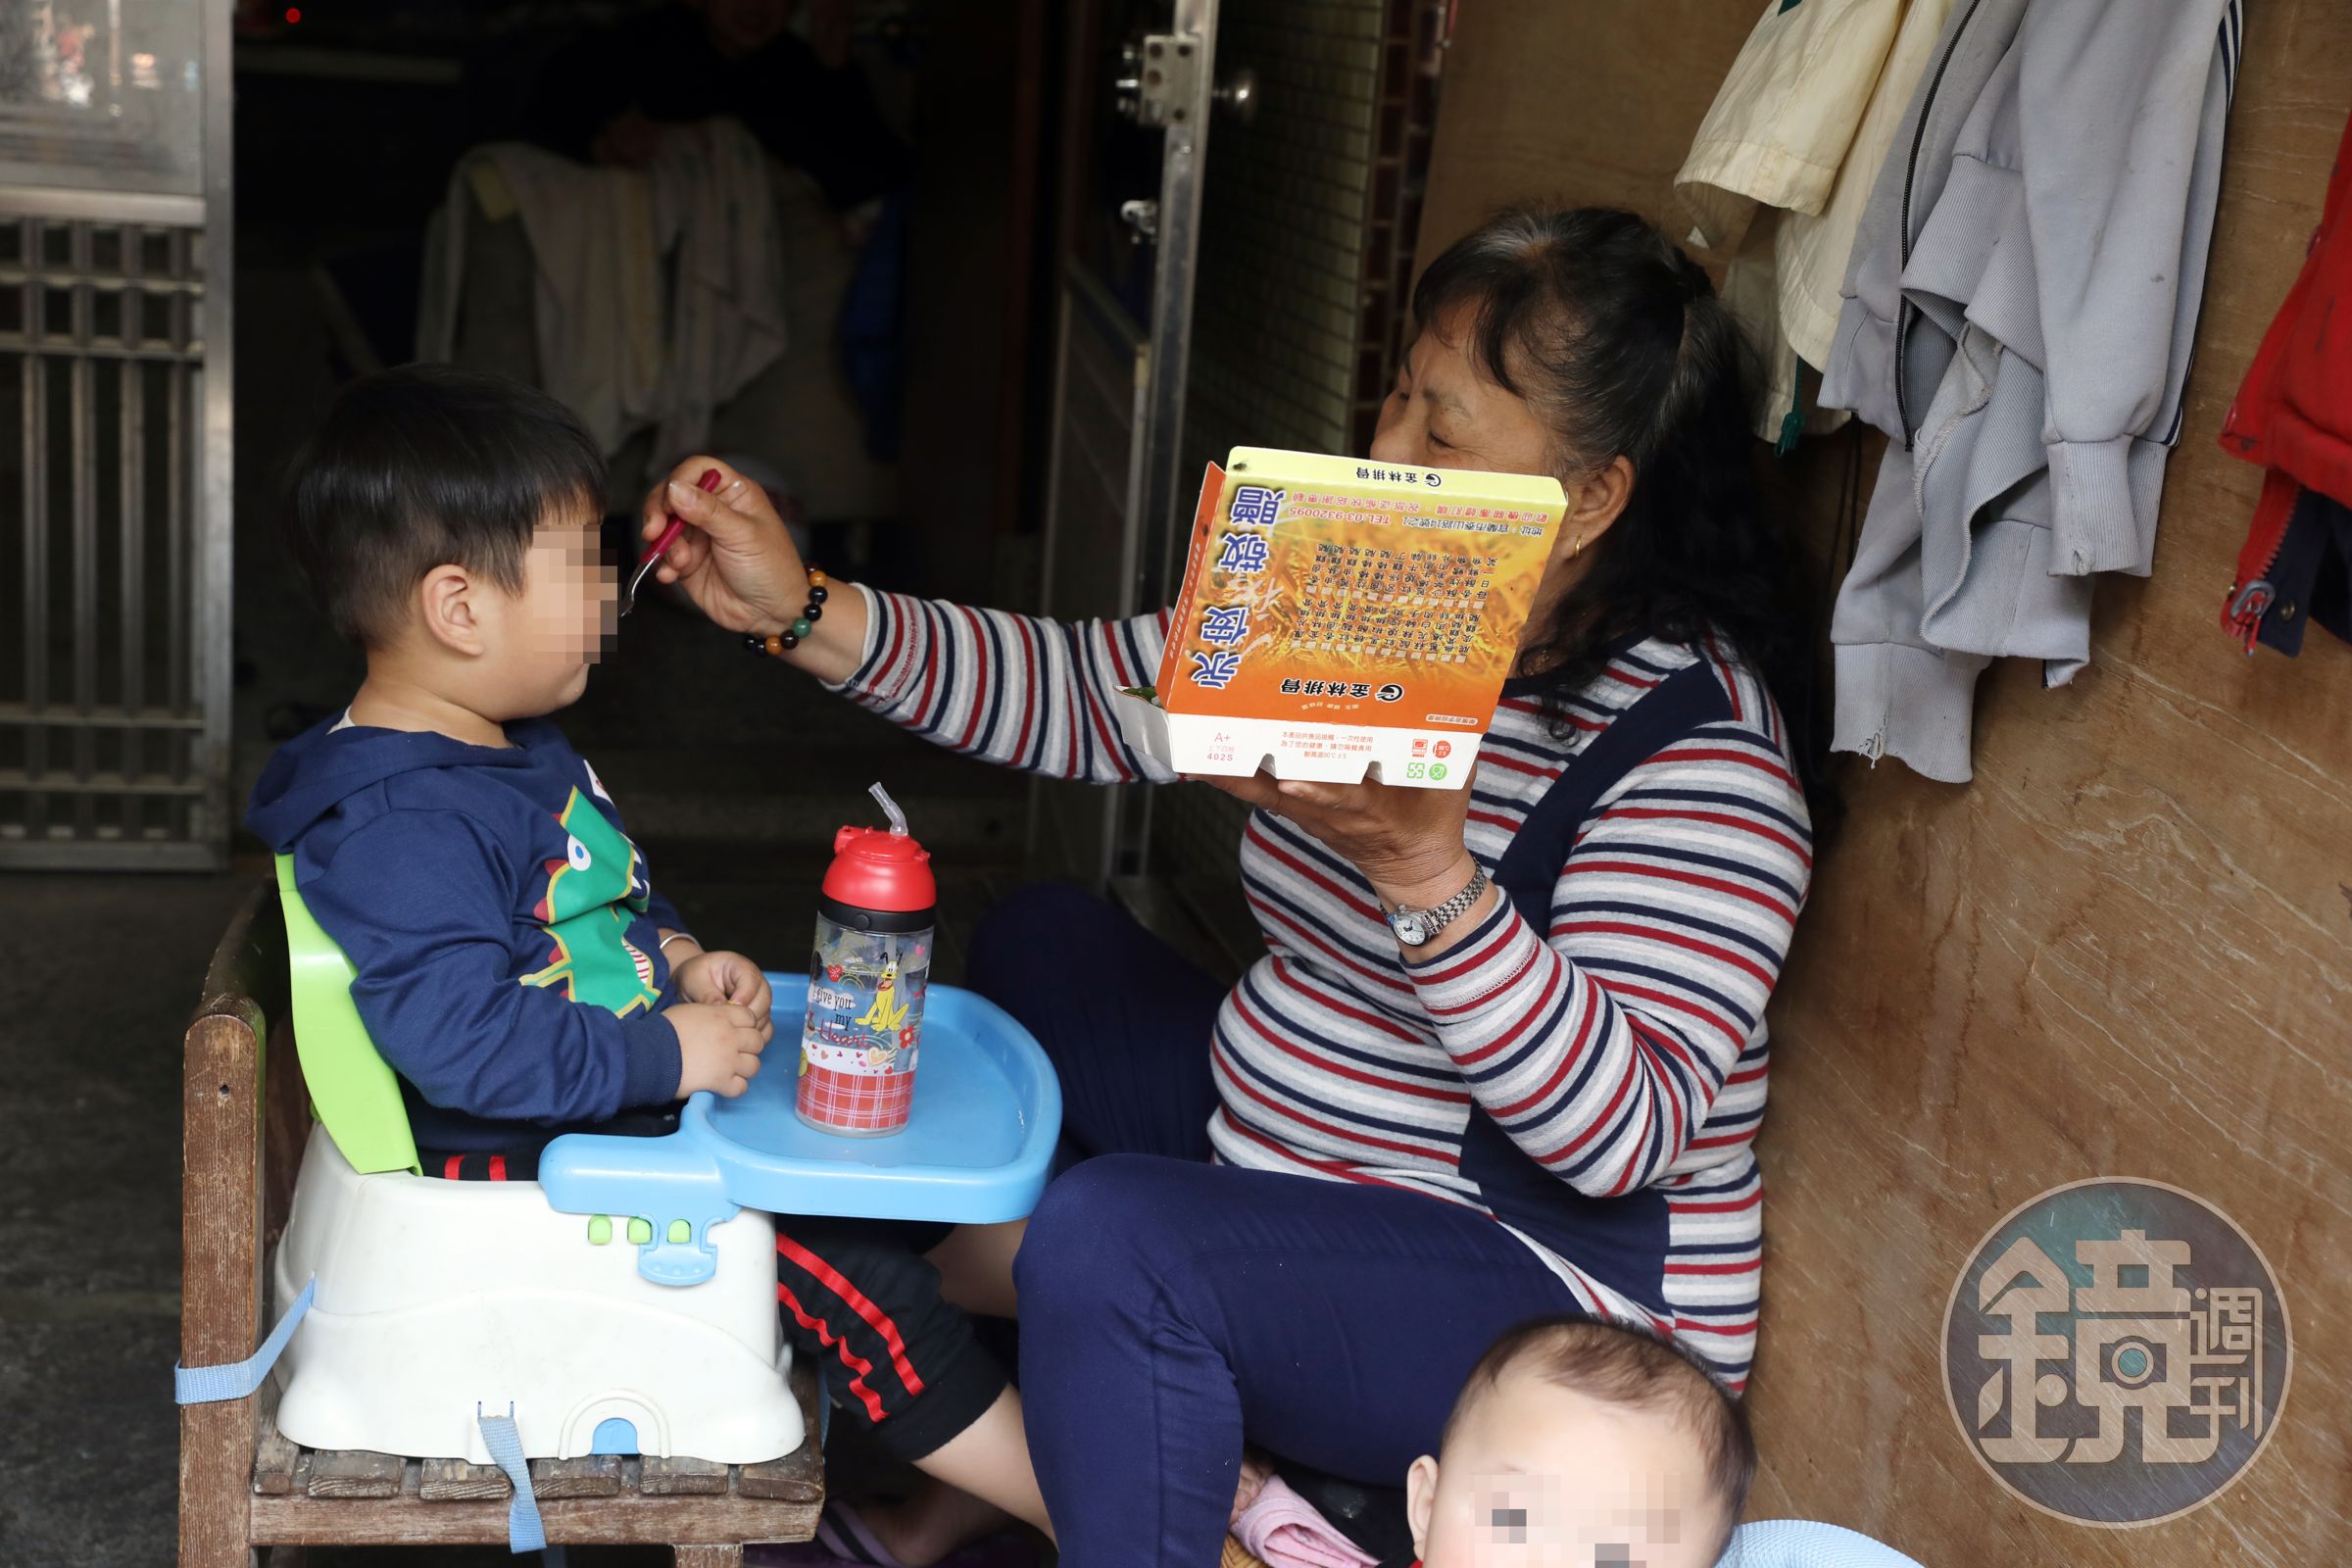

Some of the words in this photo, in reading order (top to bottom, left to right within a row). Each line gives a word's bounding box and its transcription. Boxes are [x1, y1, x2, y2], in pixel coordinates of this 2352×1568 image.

[1354, 466, 1418, 484] 金林排骨
[1278, 676, 1372, 699] 金林排骨
[1206, 753, 1233, 761] 402S
[815, 988, 832, 1004] give
[834, 995, 852, 1011] you
[835, 1012, 852, 1031] my
